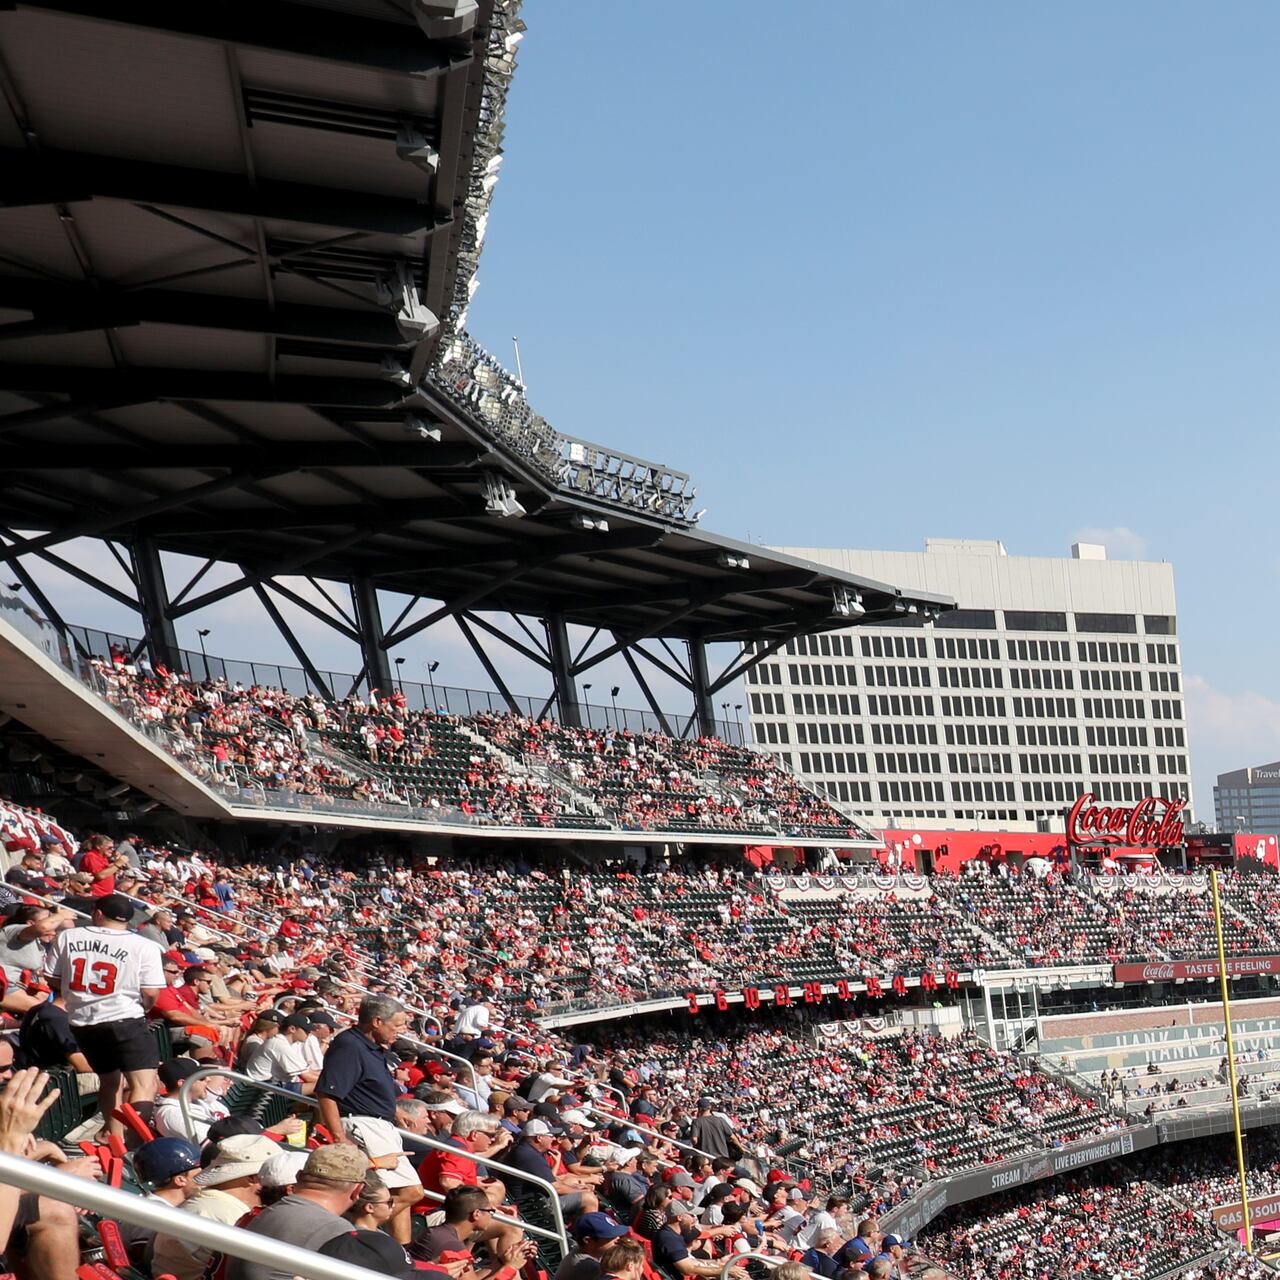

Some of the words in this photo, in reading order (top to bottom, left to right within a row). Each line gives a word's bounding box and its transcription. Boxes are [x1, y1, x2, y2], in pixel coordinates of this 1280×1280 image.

[1069, 792, 1187, 845] Coca-Cola
[69, 940, 109, 955] ACUÑA
[110, 948, 129, 963] JR.
[68, 957, 118, 996] 13
[1185, 965, 1213, 975] TASTE
[1216, 963, 1233, 973] TE
[1235, 961, 1271, 973] FEELING
[774, 985, 793, 1006] 21
[803, 982, 823, 1002] 29
[836, 980, 851, 1000] 31
[864, 977, 883, 997] 35
[685, 992, 699, 1014] 3
[716, 990, 728, 1011] 6
[743, 987, 761, 1009] 10
[991, 1169, 1021, 1189] STREAM
[1055, 1157, 1069, 1170] LIVE
[1069, 1145, 1110, 1167] EVERYWHERE
[1110, 1142, 1121, 1154] ON
[1220, 1212, 1243, 1226] GAS
